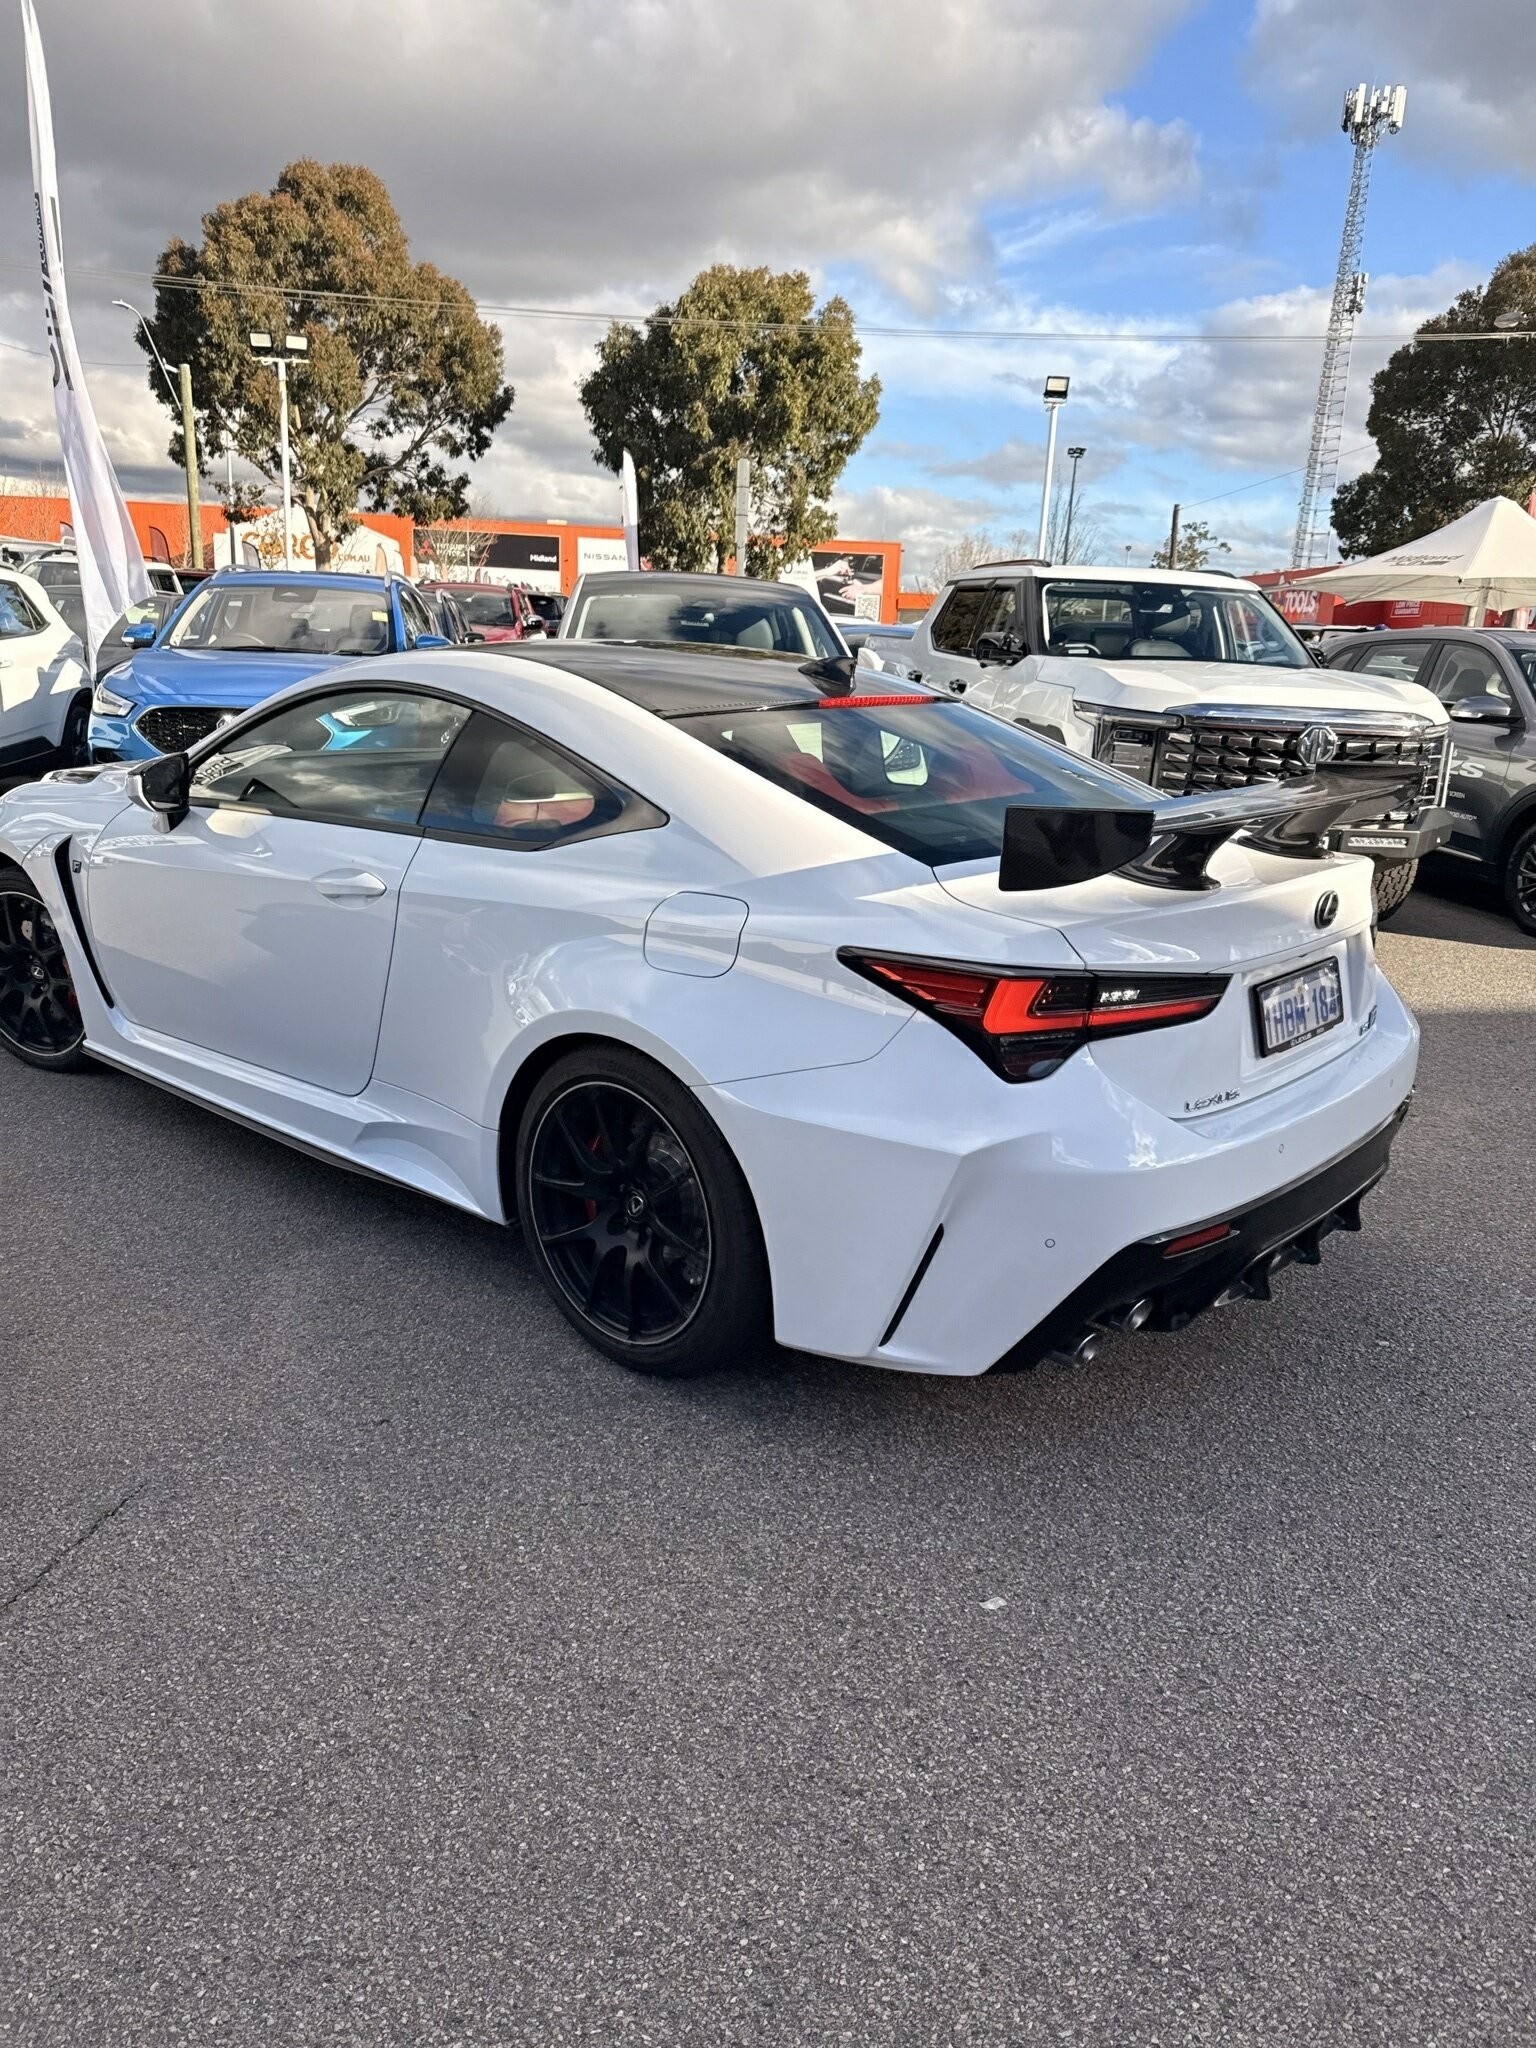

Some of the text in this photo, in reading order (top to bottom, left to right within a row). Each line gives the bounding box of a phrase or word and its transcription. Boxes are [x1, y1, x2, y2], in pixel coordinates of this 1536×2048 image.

[530, 554, 557, 563] Midland
[584, 552, 626, 561] NISSAN
[1284, 590, 1317, 614] TOOLS
[1184, 1087, 1241, 1113] LEXUS
